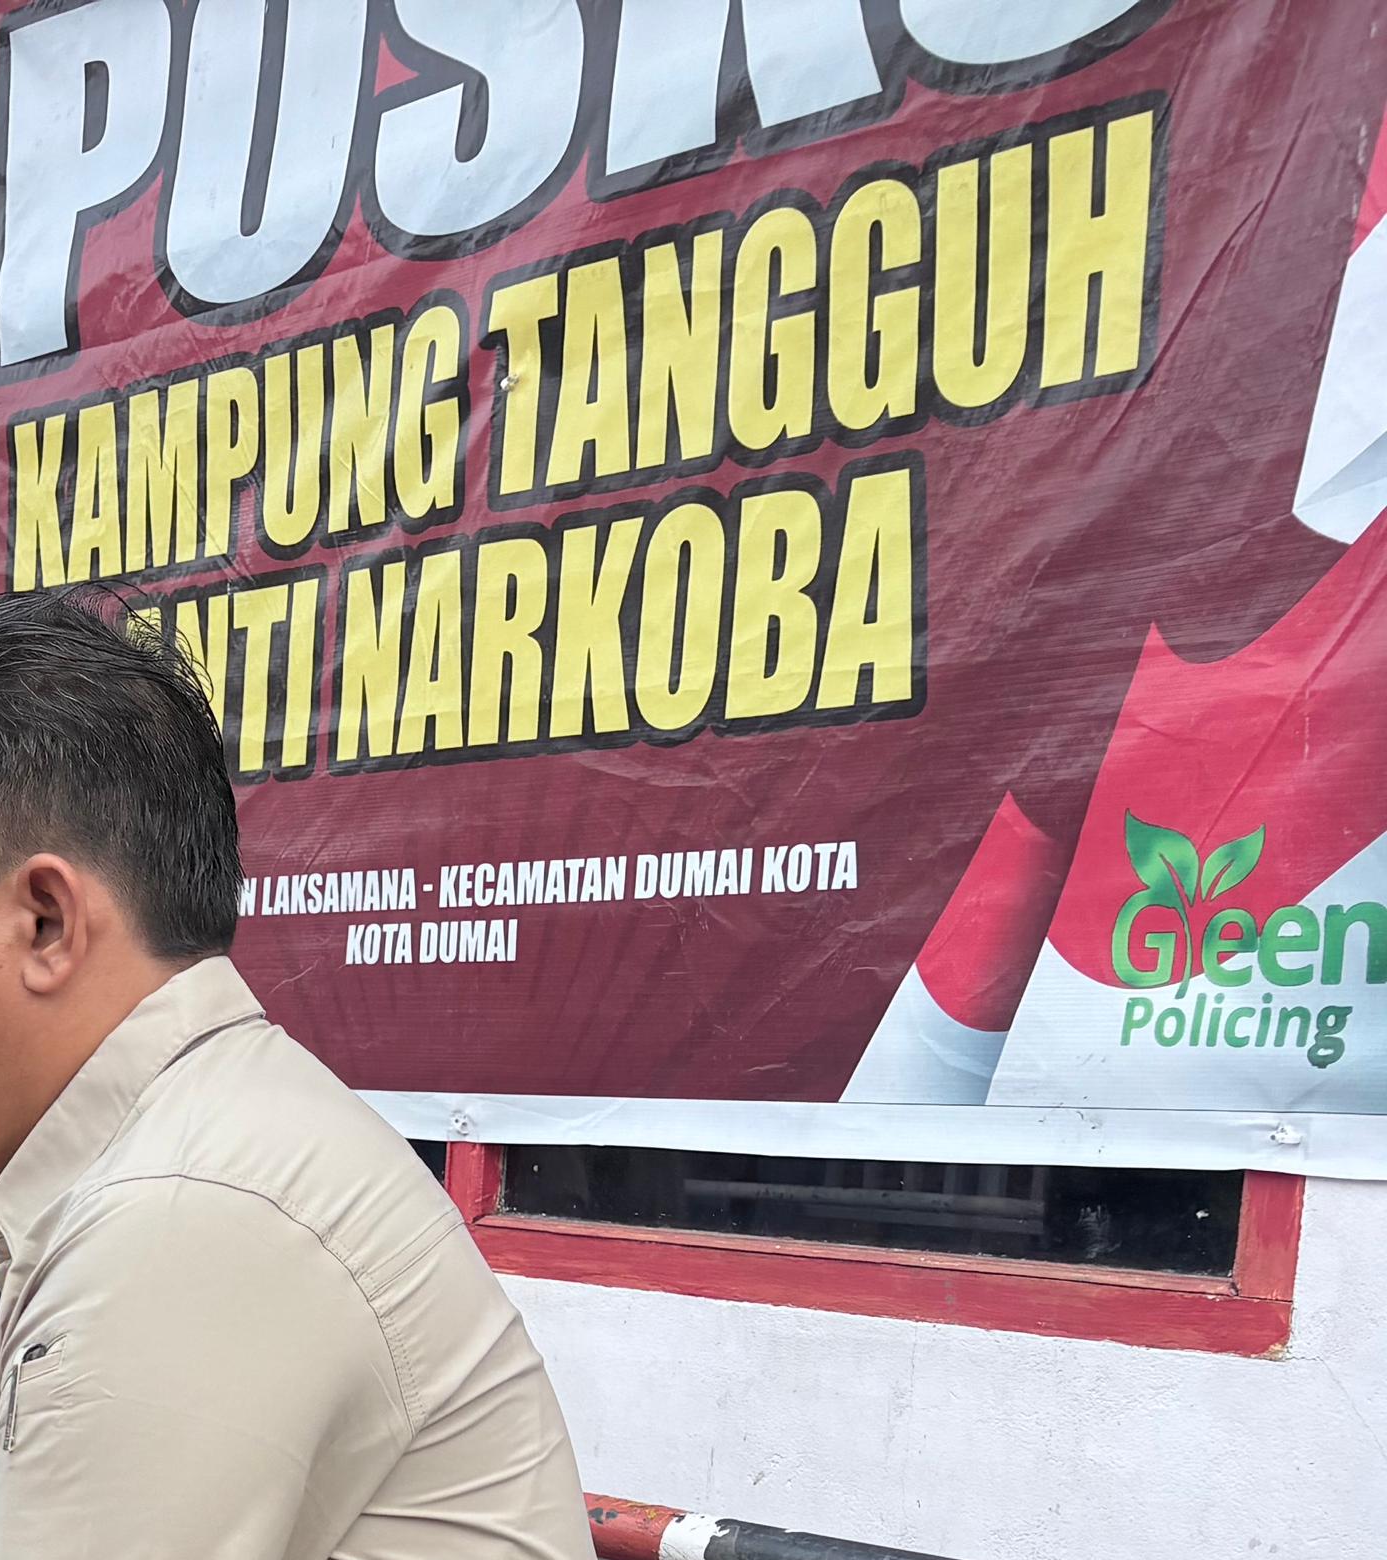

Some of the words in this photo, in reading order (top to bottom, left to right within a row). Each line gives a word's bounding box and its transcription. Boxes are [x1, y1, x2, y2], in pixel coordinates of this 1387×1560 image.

[0, 0, 1137, 366] PUS
[13, 306, 460, 592] KAMPUNG
[488, 111, 1153, 496] TANGGUH
[336, 468, 913, 762] NARKOBA
[261, 868, 416, 916] LAKSAMANA
[439, 856, 627, 908] KECAMATAN
[634, 848, 753, 899] DUMAI
[761, 841, 858, 893] KOTA
[1111, 878, 1387, 999] Green
[345, 923, 413, 965] KOTA
[419, 919, 518, 964] DUMAI
[1120, 992, 1353, 1069] Policing
